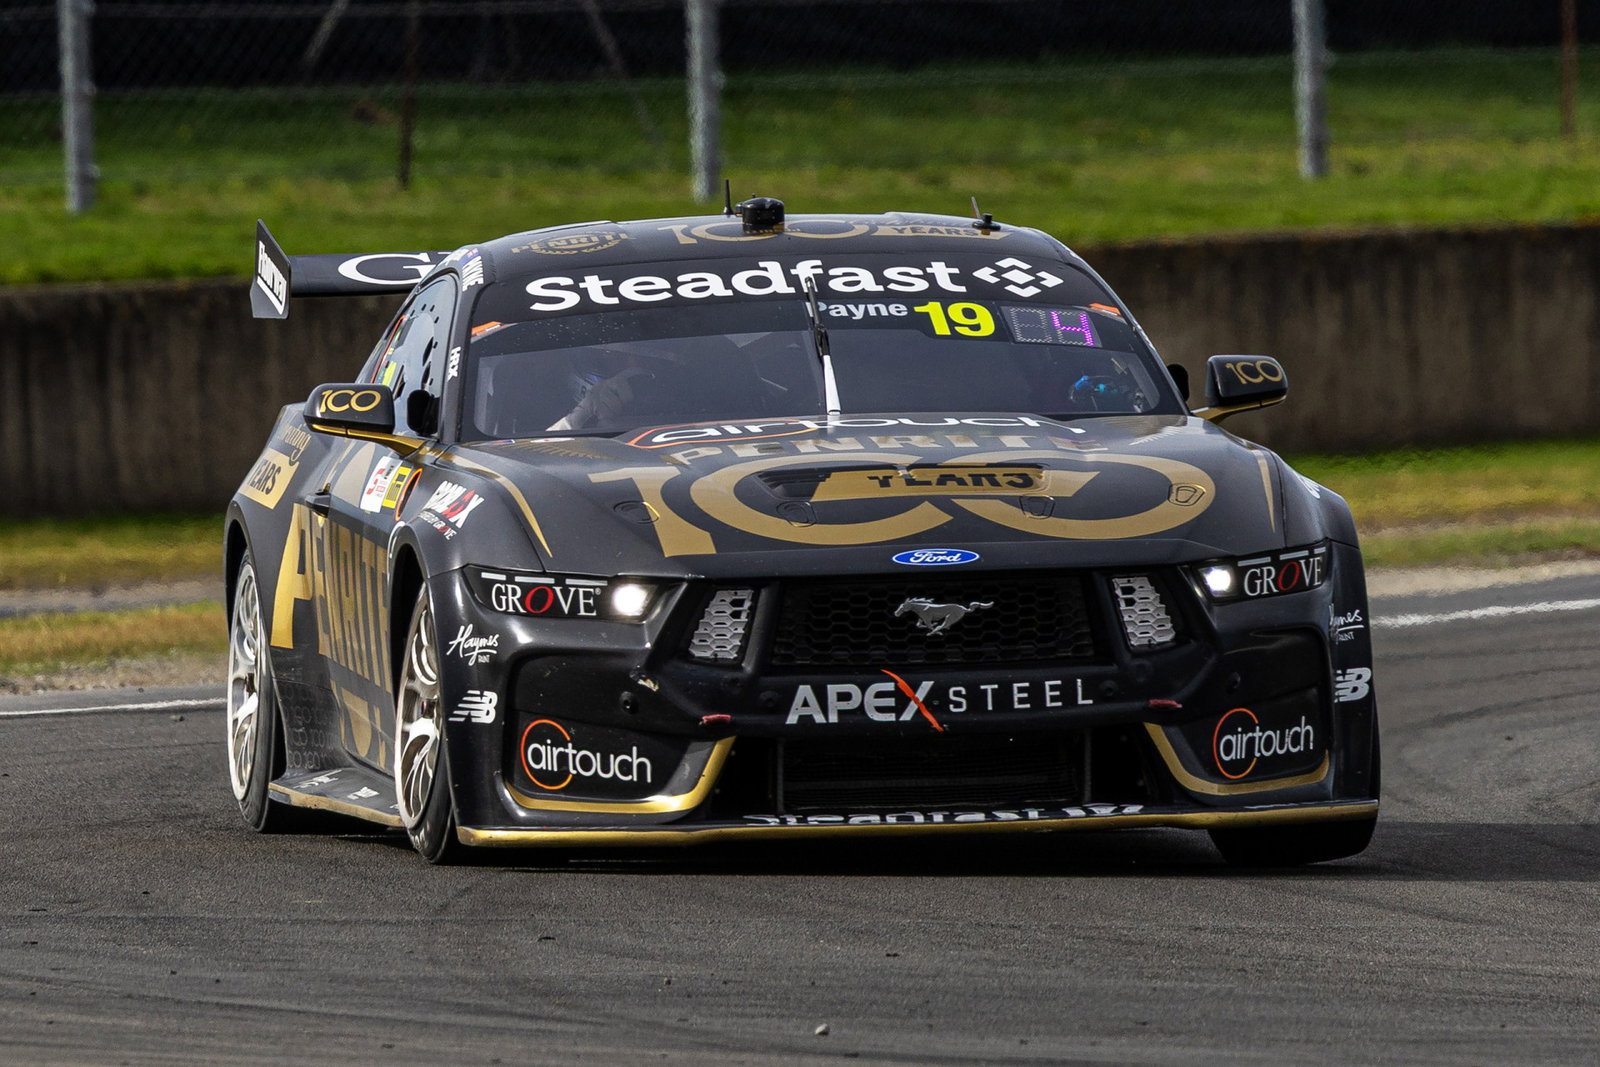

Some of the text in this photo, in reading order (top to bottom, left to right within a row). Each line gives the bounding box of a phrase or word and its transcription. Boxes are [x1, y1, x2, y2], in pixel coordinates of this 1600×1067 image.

[891, 227, 979, 237] YEARS
[525, 259, 967, 311] Steadfast
[914, 301, 995, 337] 19
[909, 549, 962, 565] Ford
[1244, 556, 1323, 596] GROVE
[785, 669, 1093, 732] APEX STEEL
[1219, 716, 1314, 761] airtouch
[527, 739, 652, 783] airtouch
